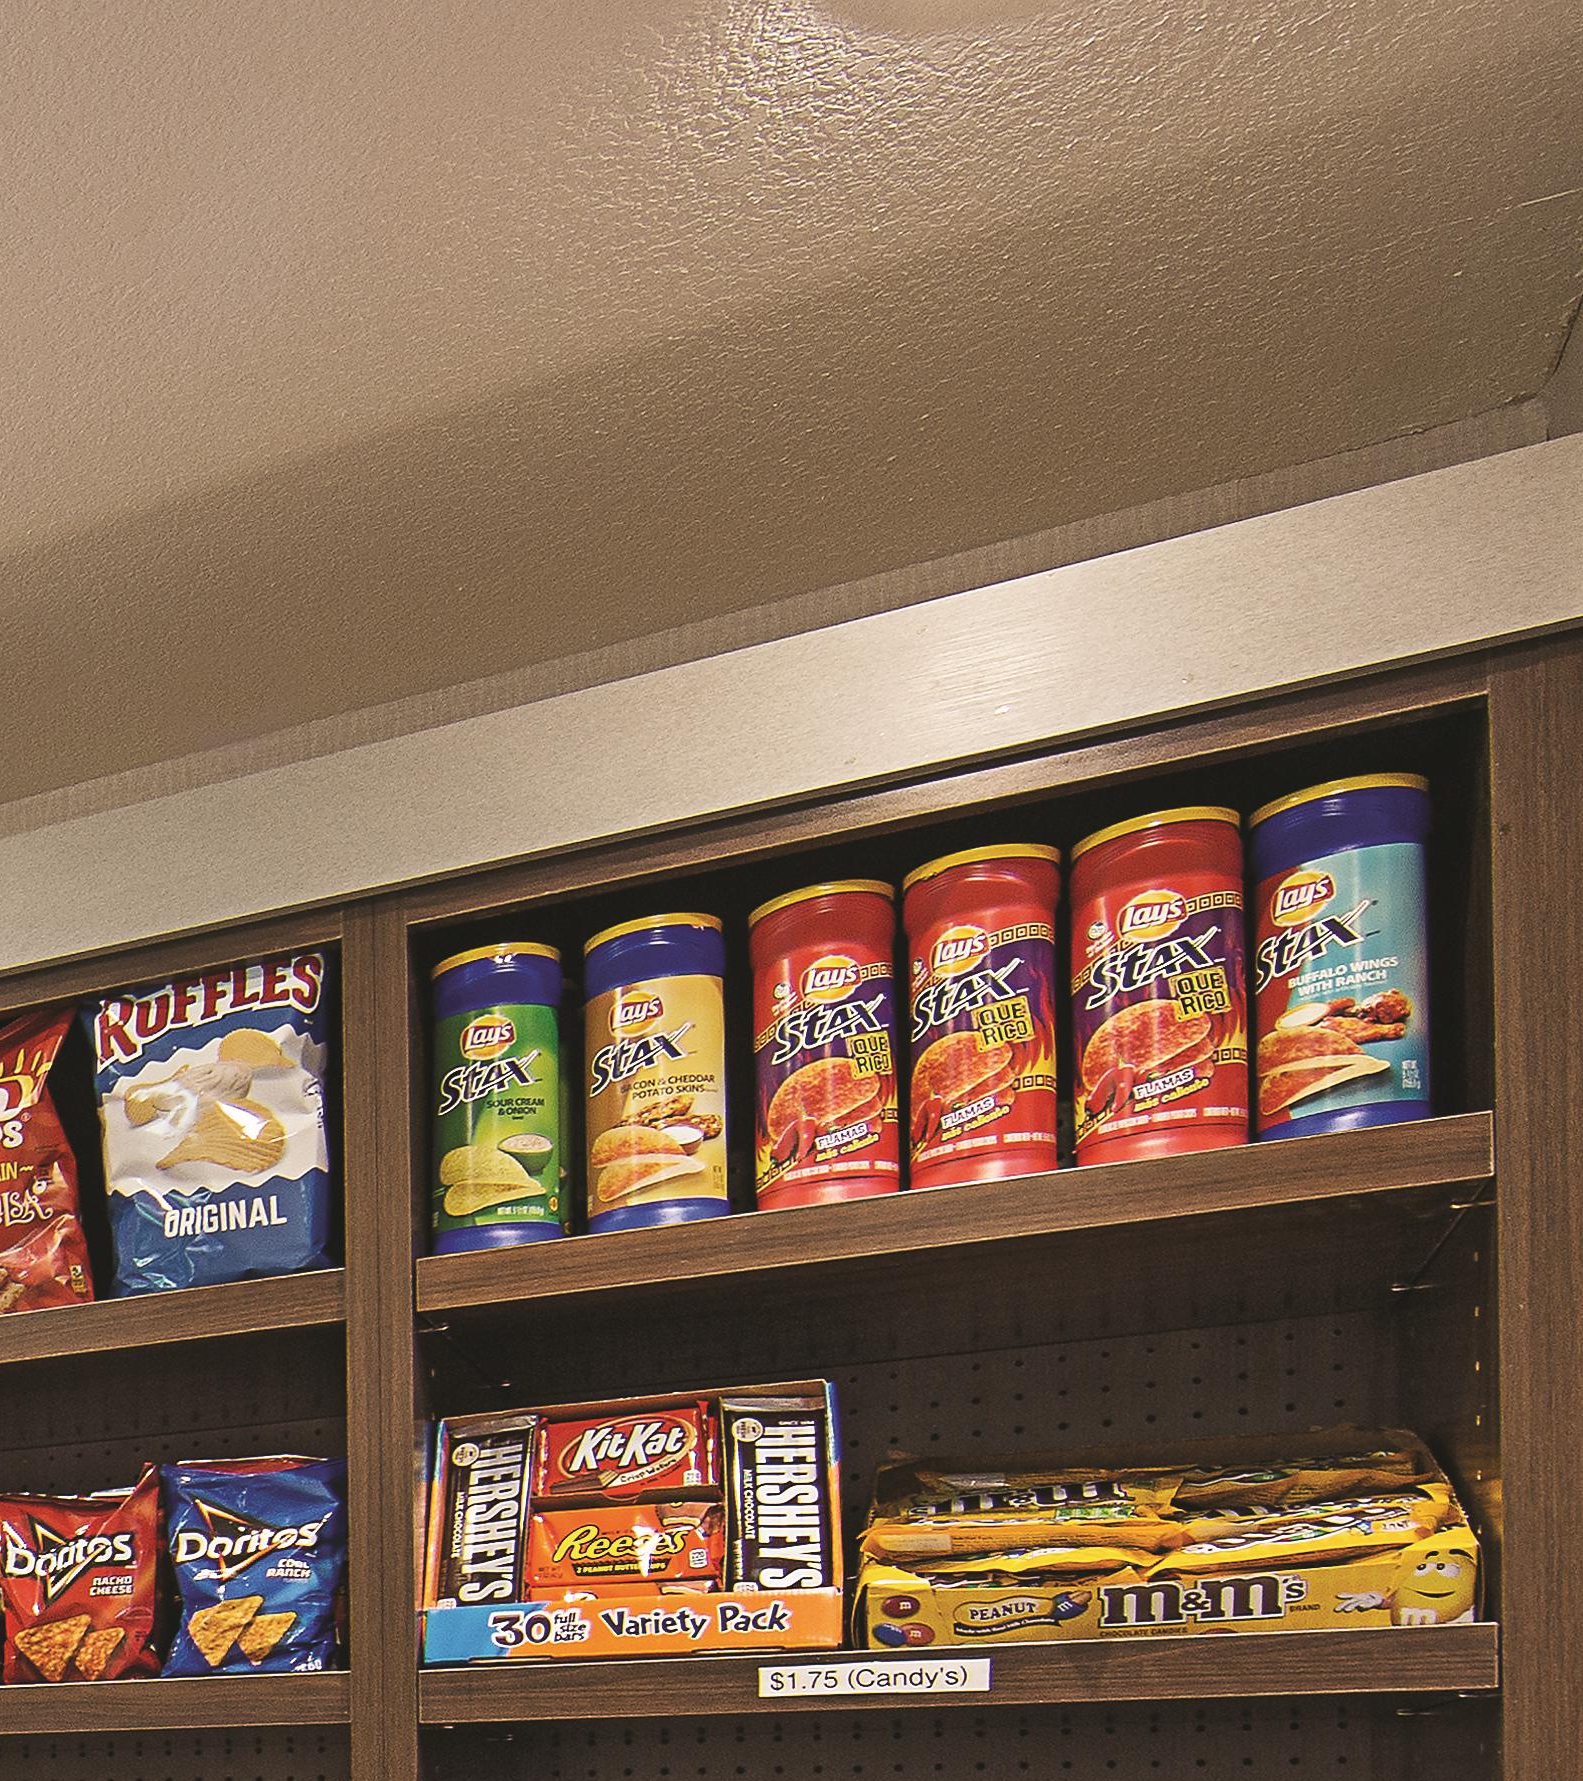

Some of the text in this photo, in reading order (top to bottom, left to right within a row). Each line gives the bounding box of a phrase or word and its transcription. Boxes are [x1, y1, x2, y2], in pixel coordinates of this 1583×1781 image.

[1288, 956, 1399, 988] BUFFALO WINGS
[1298, 970, 1386, 996] WITH RANCH
[95, 953, 324, 1070] RUFFLES
[854, 1038, 888, 1055] QUE
[855, 1056, 889, 1073] RICO
[620, 1078, 655, 1092] BACON
[669, 1074, 716, 1087] CHEDDAR
[632, 1085, 705, 1100] POTATO SKINS
[486, 1098, 545, 1111] SOUR CREAM
[165, 1195, 288, 1238] ORIGINAL
[176, 1524, 320, 1565] Doritos
[602, 1603, 788, 1639] Variety Pack
[969, 1601, 1036, 1621] PEANUT
[491, 1612, 551, 1648] 30
[770, 1665, 969, 1691] $1.75 (Candy's)
